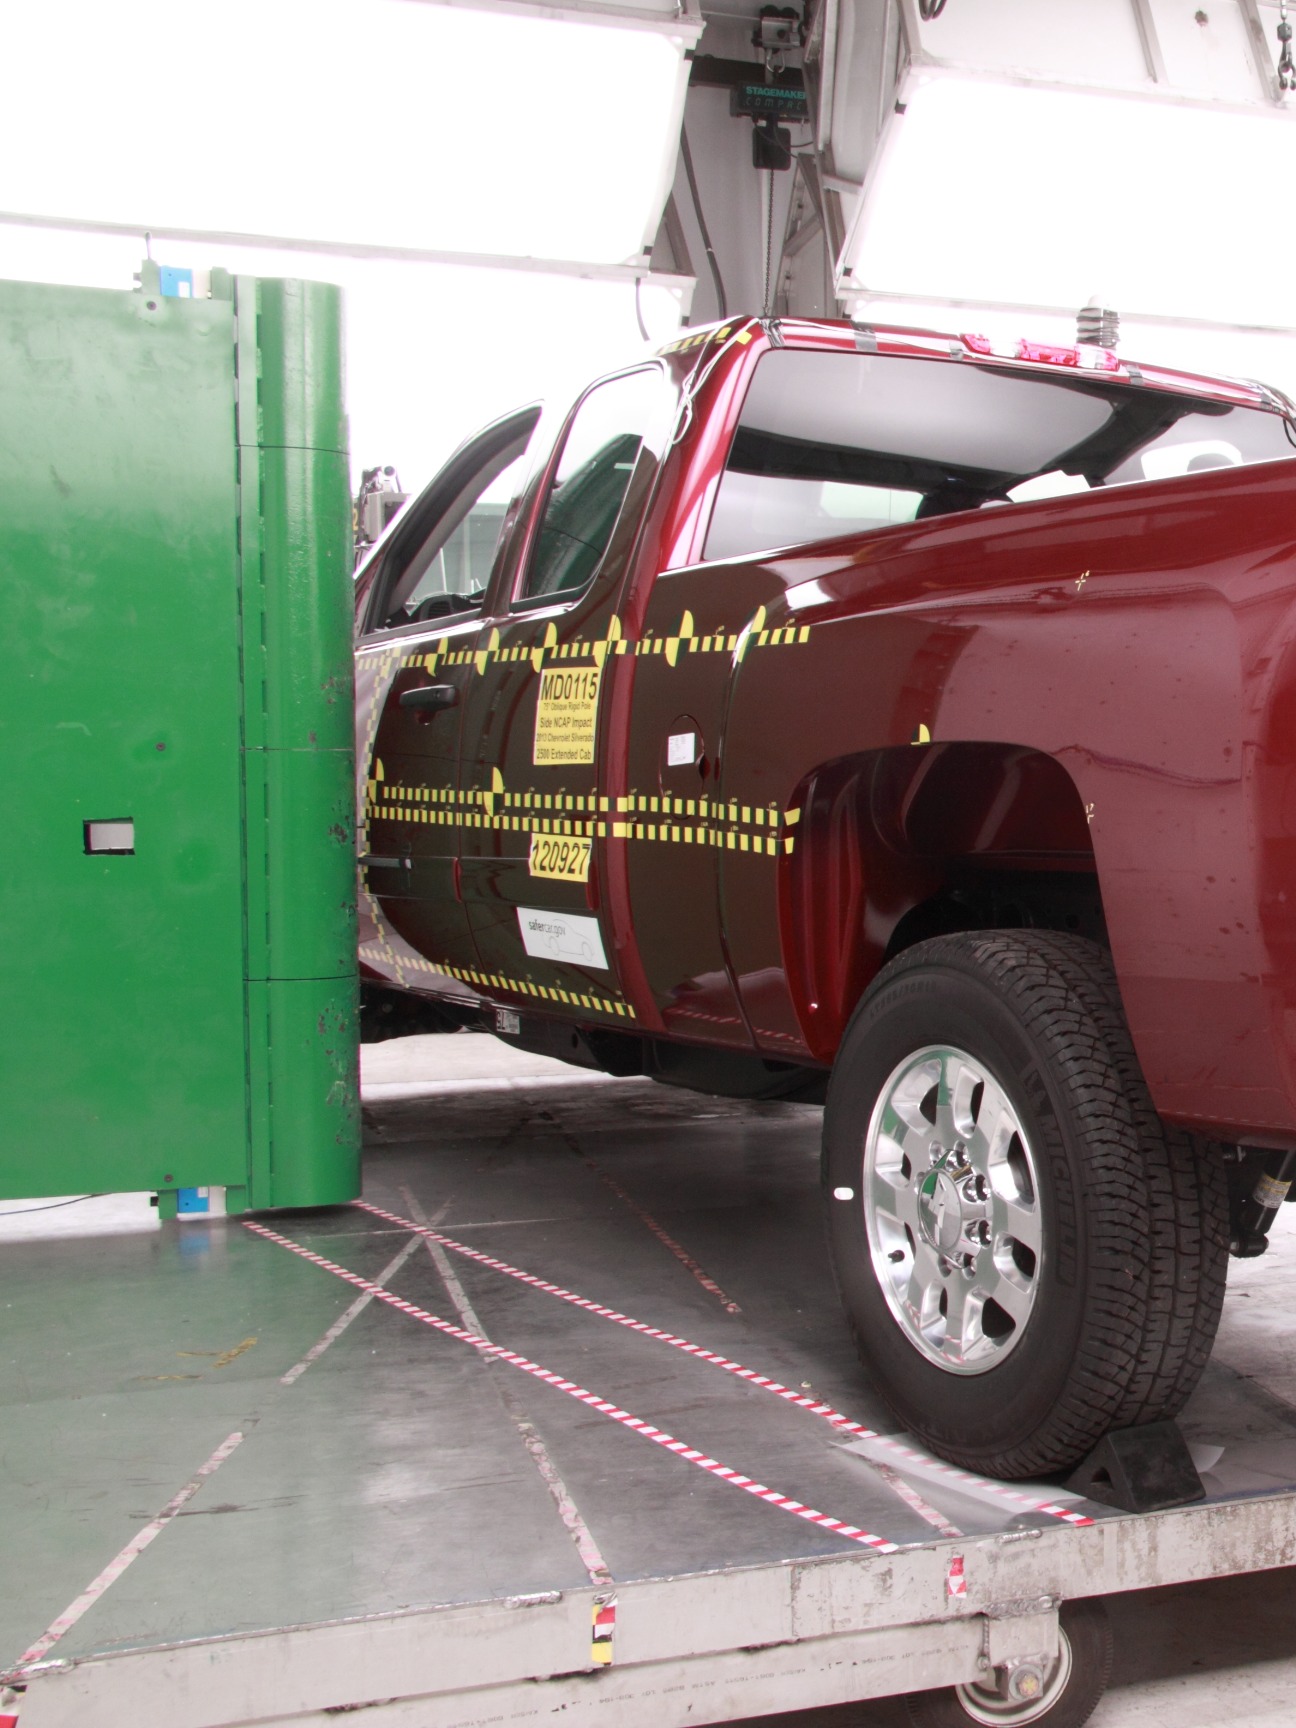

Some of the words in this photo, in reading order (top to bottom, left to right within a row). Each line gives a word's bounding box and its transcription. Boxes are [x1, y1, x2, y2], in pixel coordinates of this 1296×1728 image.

[541, 672, 598, 701] MD0115
[541, 717, 552, 728] Side
[554, 717, 571, 728] NCAP
[571, 717, 592, 730] Impact
[551, 748, 578, 760] Extended
[580, 748, 591, 760] Cab
[533, 840, 591, 875] 120927
[528, 918, 566, 937] safercar.gov
